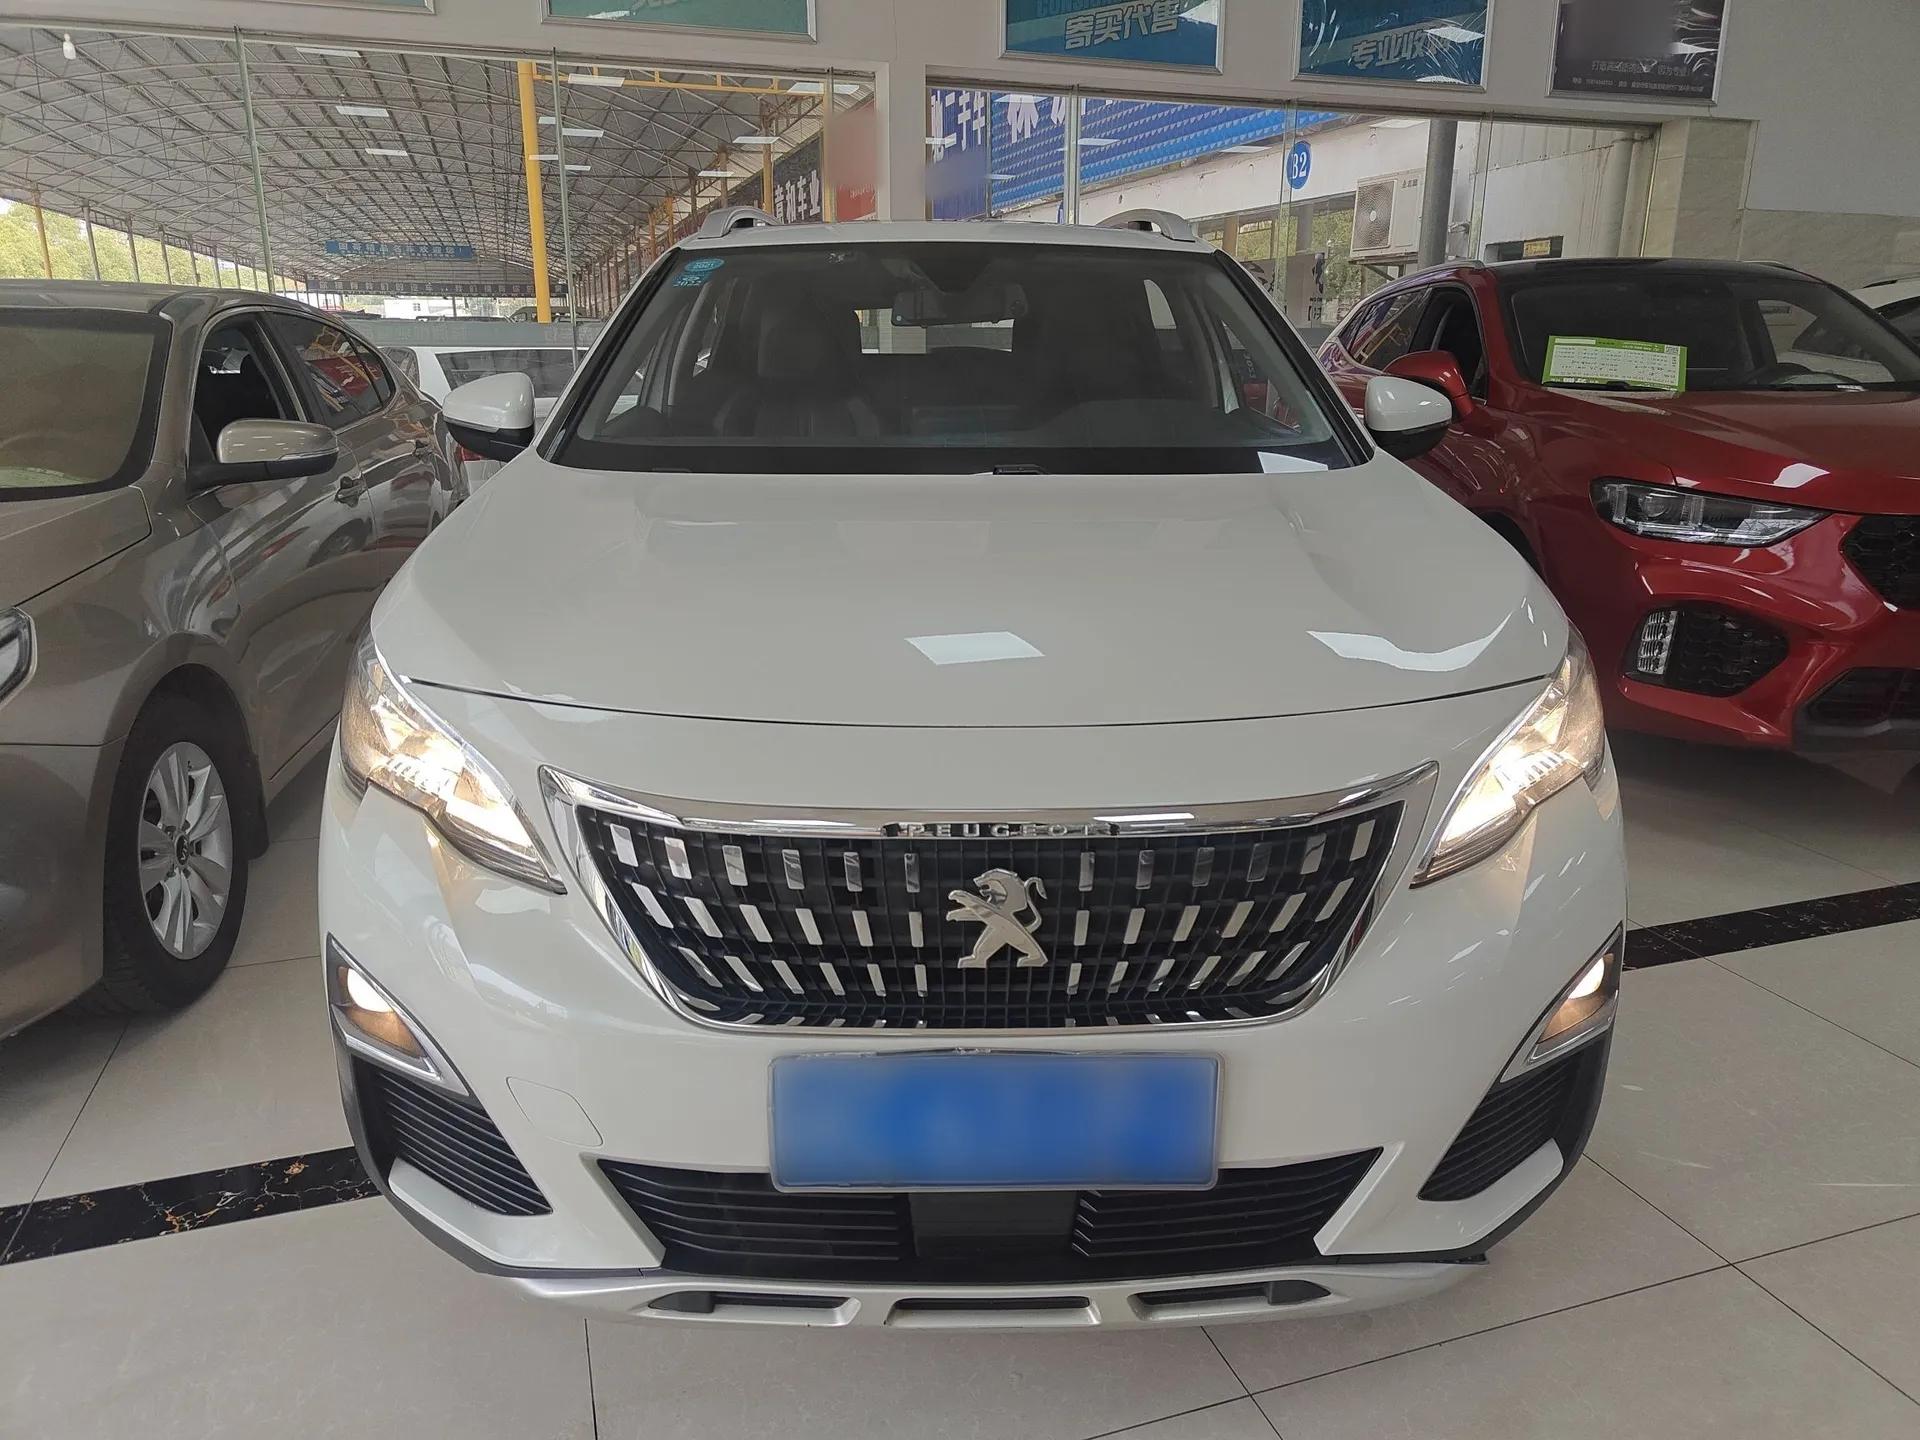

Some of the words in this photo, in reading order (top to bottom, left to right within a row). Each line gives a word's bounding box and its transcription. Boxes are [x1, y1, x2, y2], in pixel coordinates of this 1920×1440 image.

[1065, 1, 1179, 49] 寄买代售
[906, 822, 1098, 838] PEUGEOT
